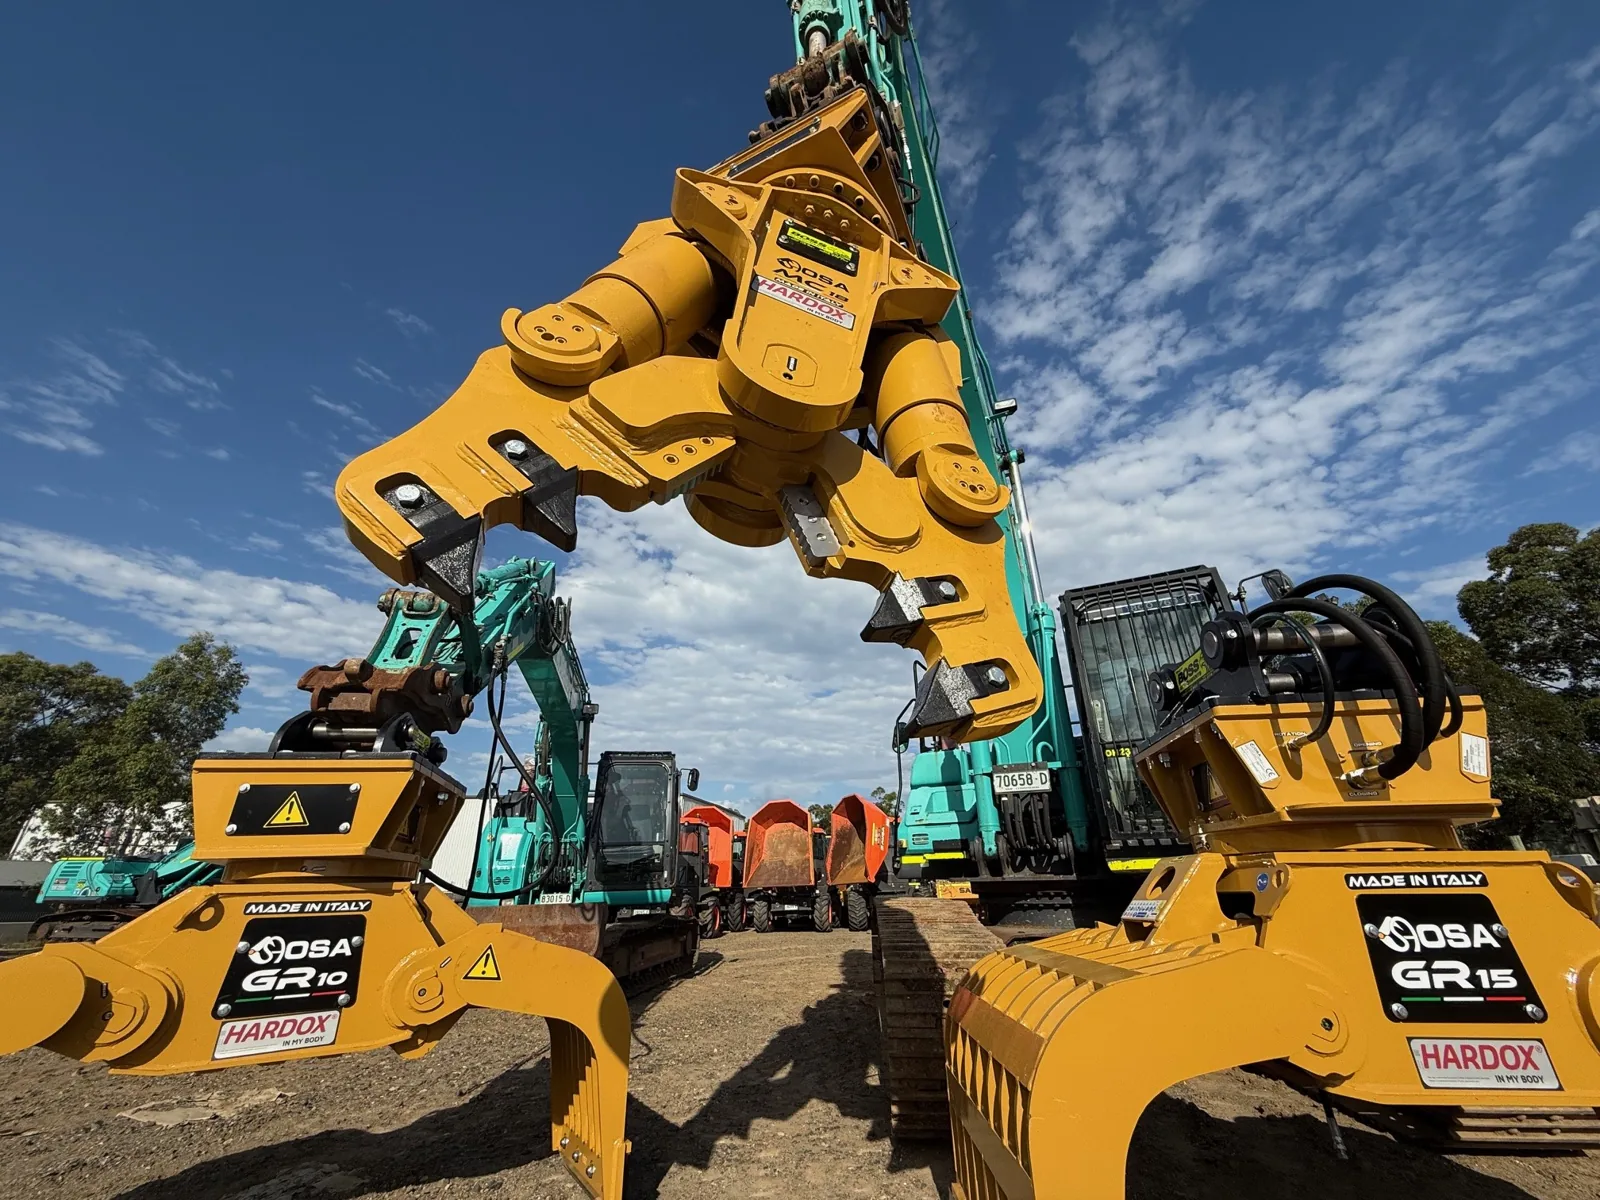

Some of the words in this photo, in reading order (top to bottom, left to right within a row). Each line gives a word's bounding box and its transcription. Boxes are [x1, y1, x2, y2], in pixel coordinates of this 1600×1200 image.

[758, 279, 848, 320] HARDOX
[995, 773, 1033, 788] 70658
[1349, 875, 1406, 887] MADE
[1410, 875, 1429, 886] IN
[1432, 873, 1483, 886] ITALY
[245, 903, 301, 914] MADE
[304, 902, 322, 912] IN
[324, 900, 371, 912] ITALY
[1415, 923, 1501, 949] OSA
[284, 938, 352, 960] OSA
[223, 1014, 331, 1045] HARDOX
[282, 1039, 291, 1047] IN
[291, 1038, 303, 1046] MY
[304, 1035, 325, 1045] BODY
[1420, 1043, 1540, 1071] HARDOX
[1495, 1075, 1505, 1084] IN
[1506, 1075, 1519, 1084] MY
[1521, 1075, 1545, 1084] BODY
